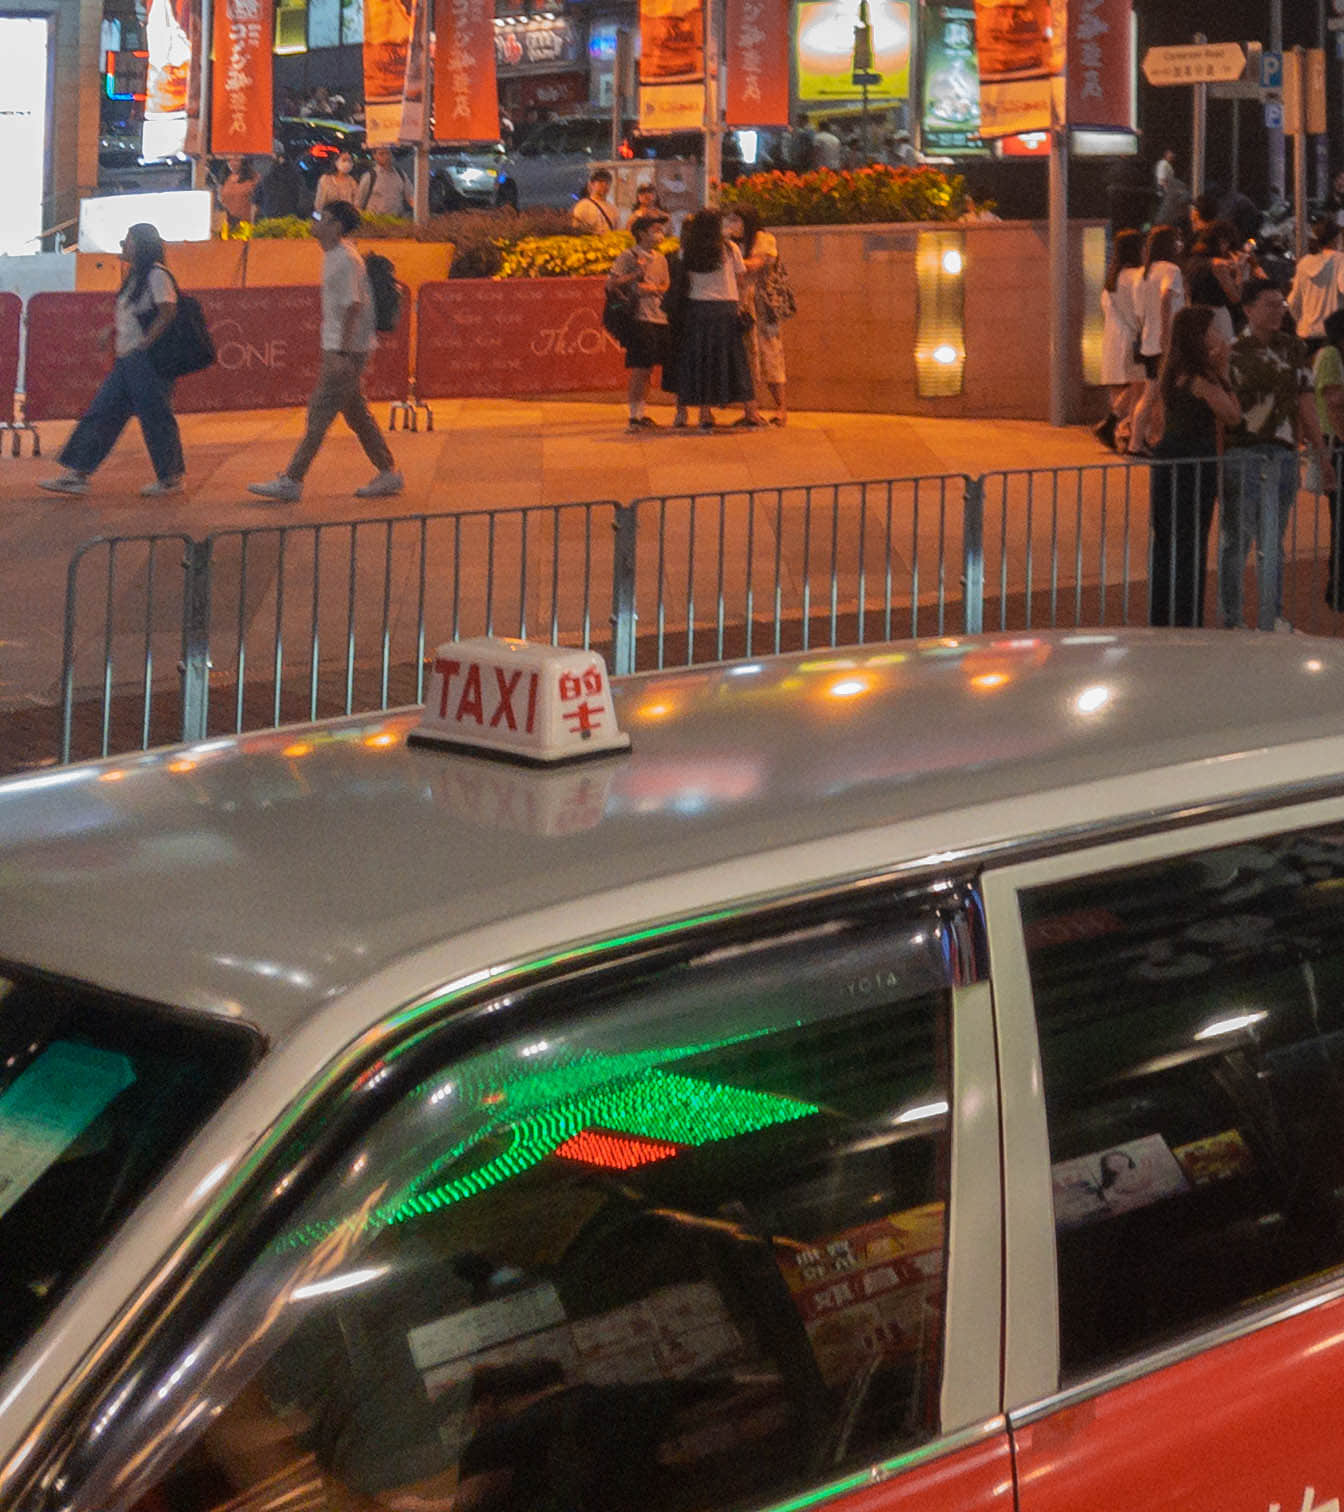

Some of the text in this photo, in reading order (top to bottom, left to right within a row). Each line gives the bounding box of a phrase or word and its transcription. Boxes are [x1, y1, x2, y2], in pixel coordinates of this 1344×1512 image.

[217, 341, 289, 370] ONE
[435, 658, 539, 734] TAXI
[559, 664, 605, 734] 的士
